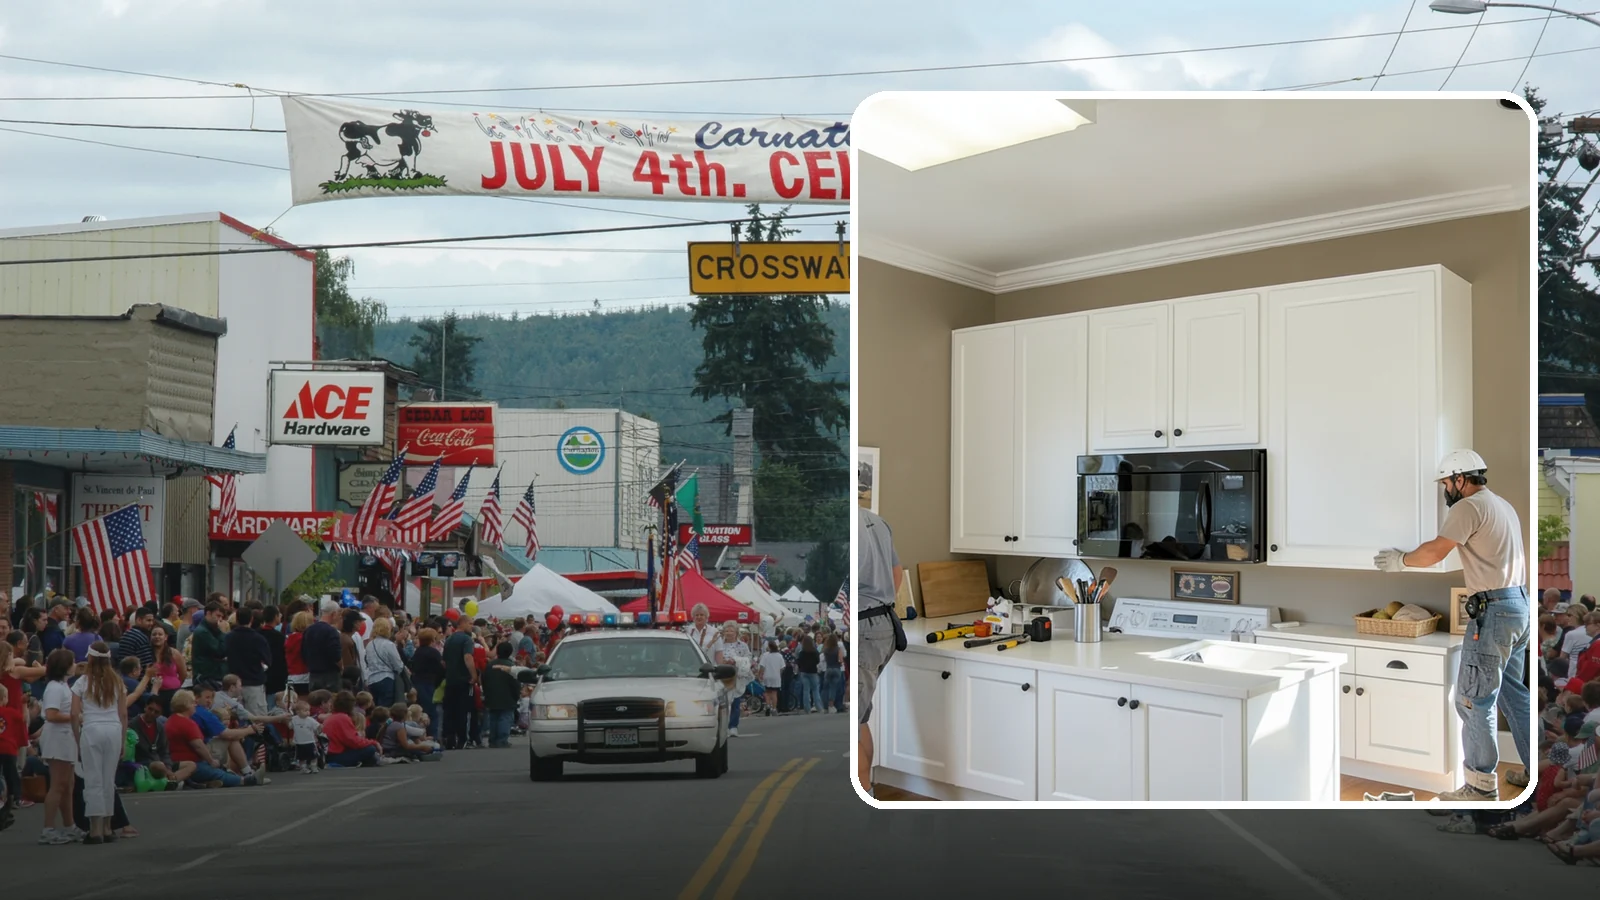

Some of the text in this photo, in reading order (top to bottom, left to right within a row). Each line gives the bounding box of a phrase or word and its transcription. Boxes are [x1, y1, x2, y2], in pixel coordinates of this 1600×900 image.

[481, 141, 605, 192] JULY
[632, 150, 746, 197] 4th.
[697, 254, 850, 280] CROSSWA
[283, 380, 373, 420] ACE
[406, 409, 452, 421] CEDAR
[283, 421, 370, 436] Hardware
[416, 428, 477, 447] Coca-Cola
[354, 466, 384, 479] Simpl
[95, 485, 124, 494] Vincent
[126, 485, 135, 494] de
[137, 486, 155, 495] Paul
[212, 516, 330, 536] HARDARE
[688, 526, 741, 535] CRNATION
[699, 535, 730, 543] GLASS
